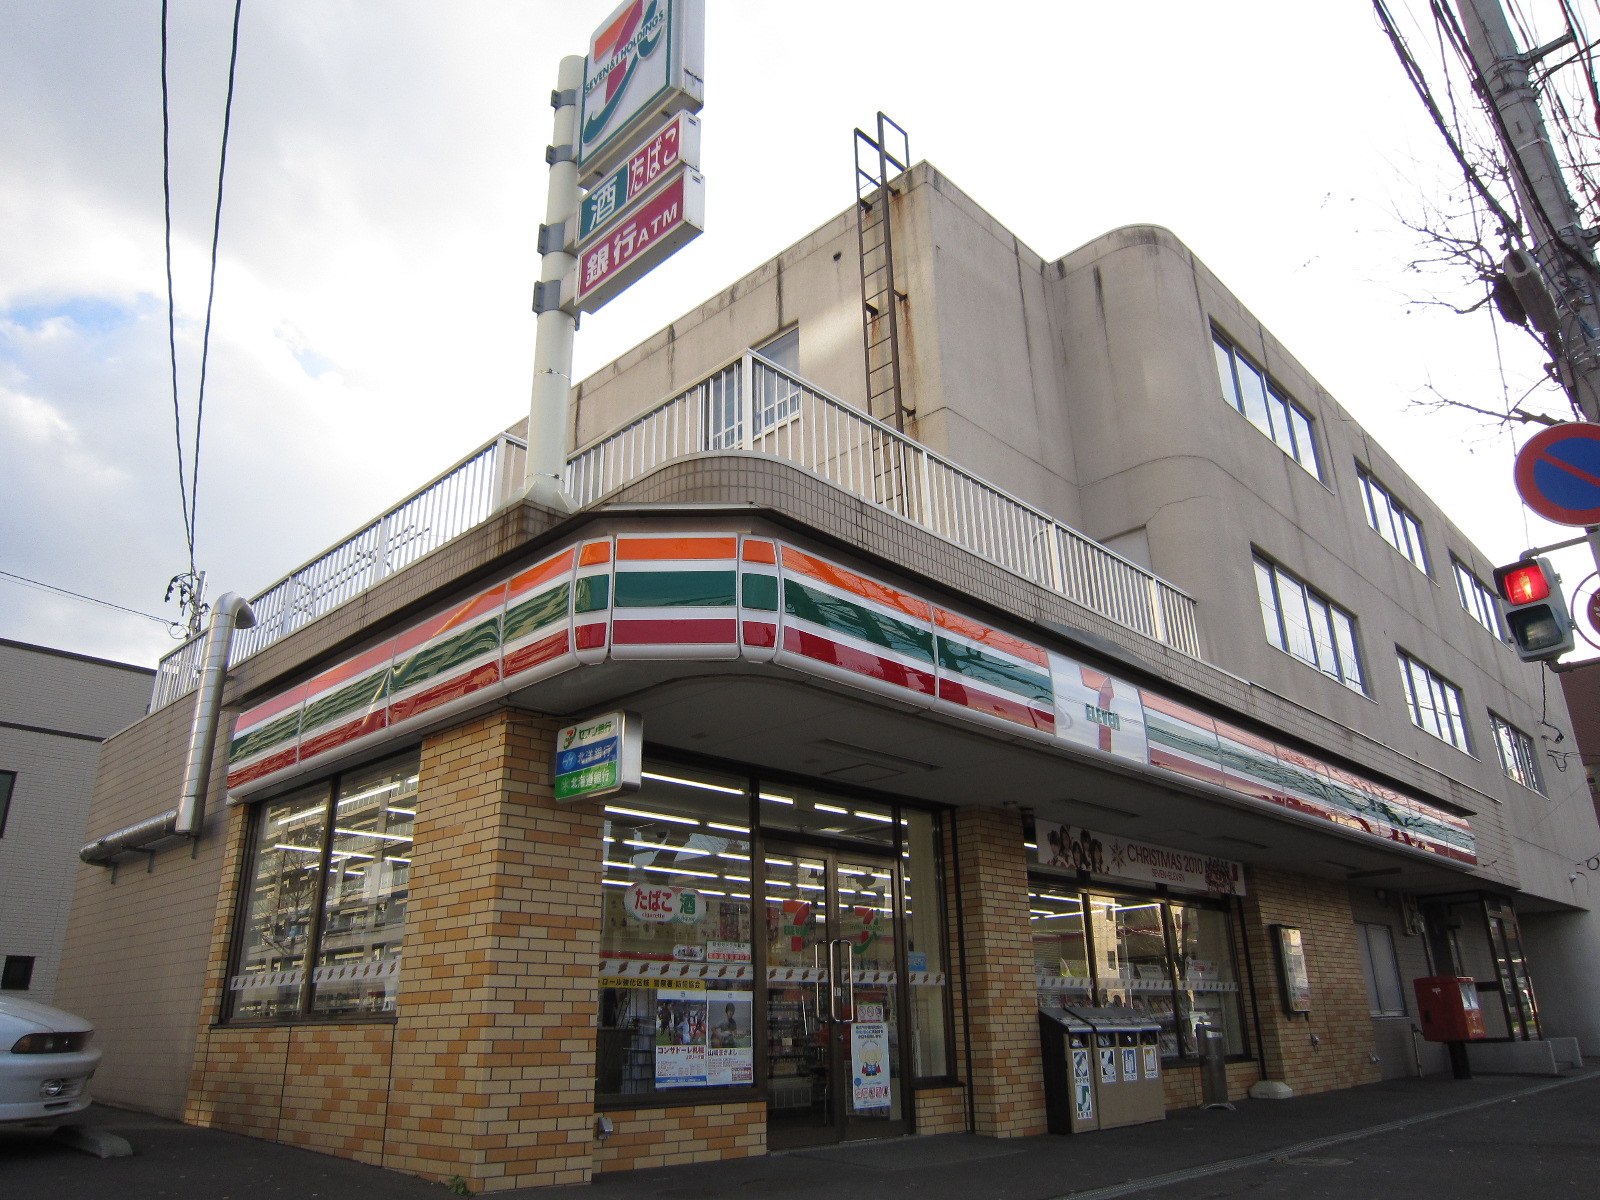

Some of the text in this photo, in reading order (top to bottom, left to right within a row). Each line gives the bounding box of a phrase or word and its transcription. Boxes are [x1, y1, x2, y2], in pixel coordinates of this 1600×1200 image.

[620, 10, 664, 60] HOLDINGS
[589, 127, 677, 231] 酒 たばこ
[585, 202, 678, 288] 銀行 ATM
[578, 720, 612, 740] セブン銀行
[577, 744, 612, 765] 北洋銀行
[570, 768, 610, 789] 北海道銀行
[1126, 844, 1203, 875] CHRISTMAS 2010
[1151, 867, 1186, 883] SEVEN-ELEVEN
[634, 888, 696, 915] たばこ 酒
[598, 978, 650, 987] ロール強化区域
